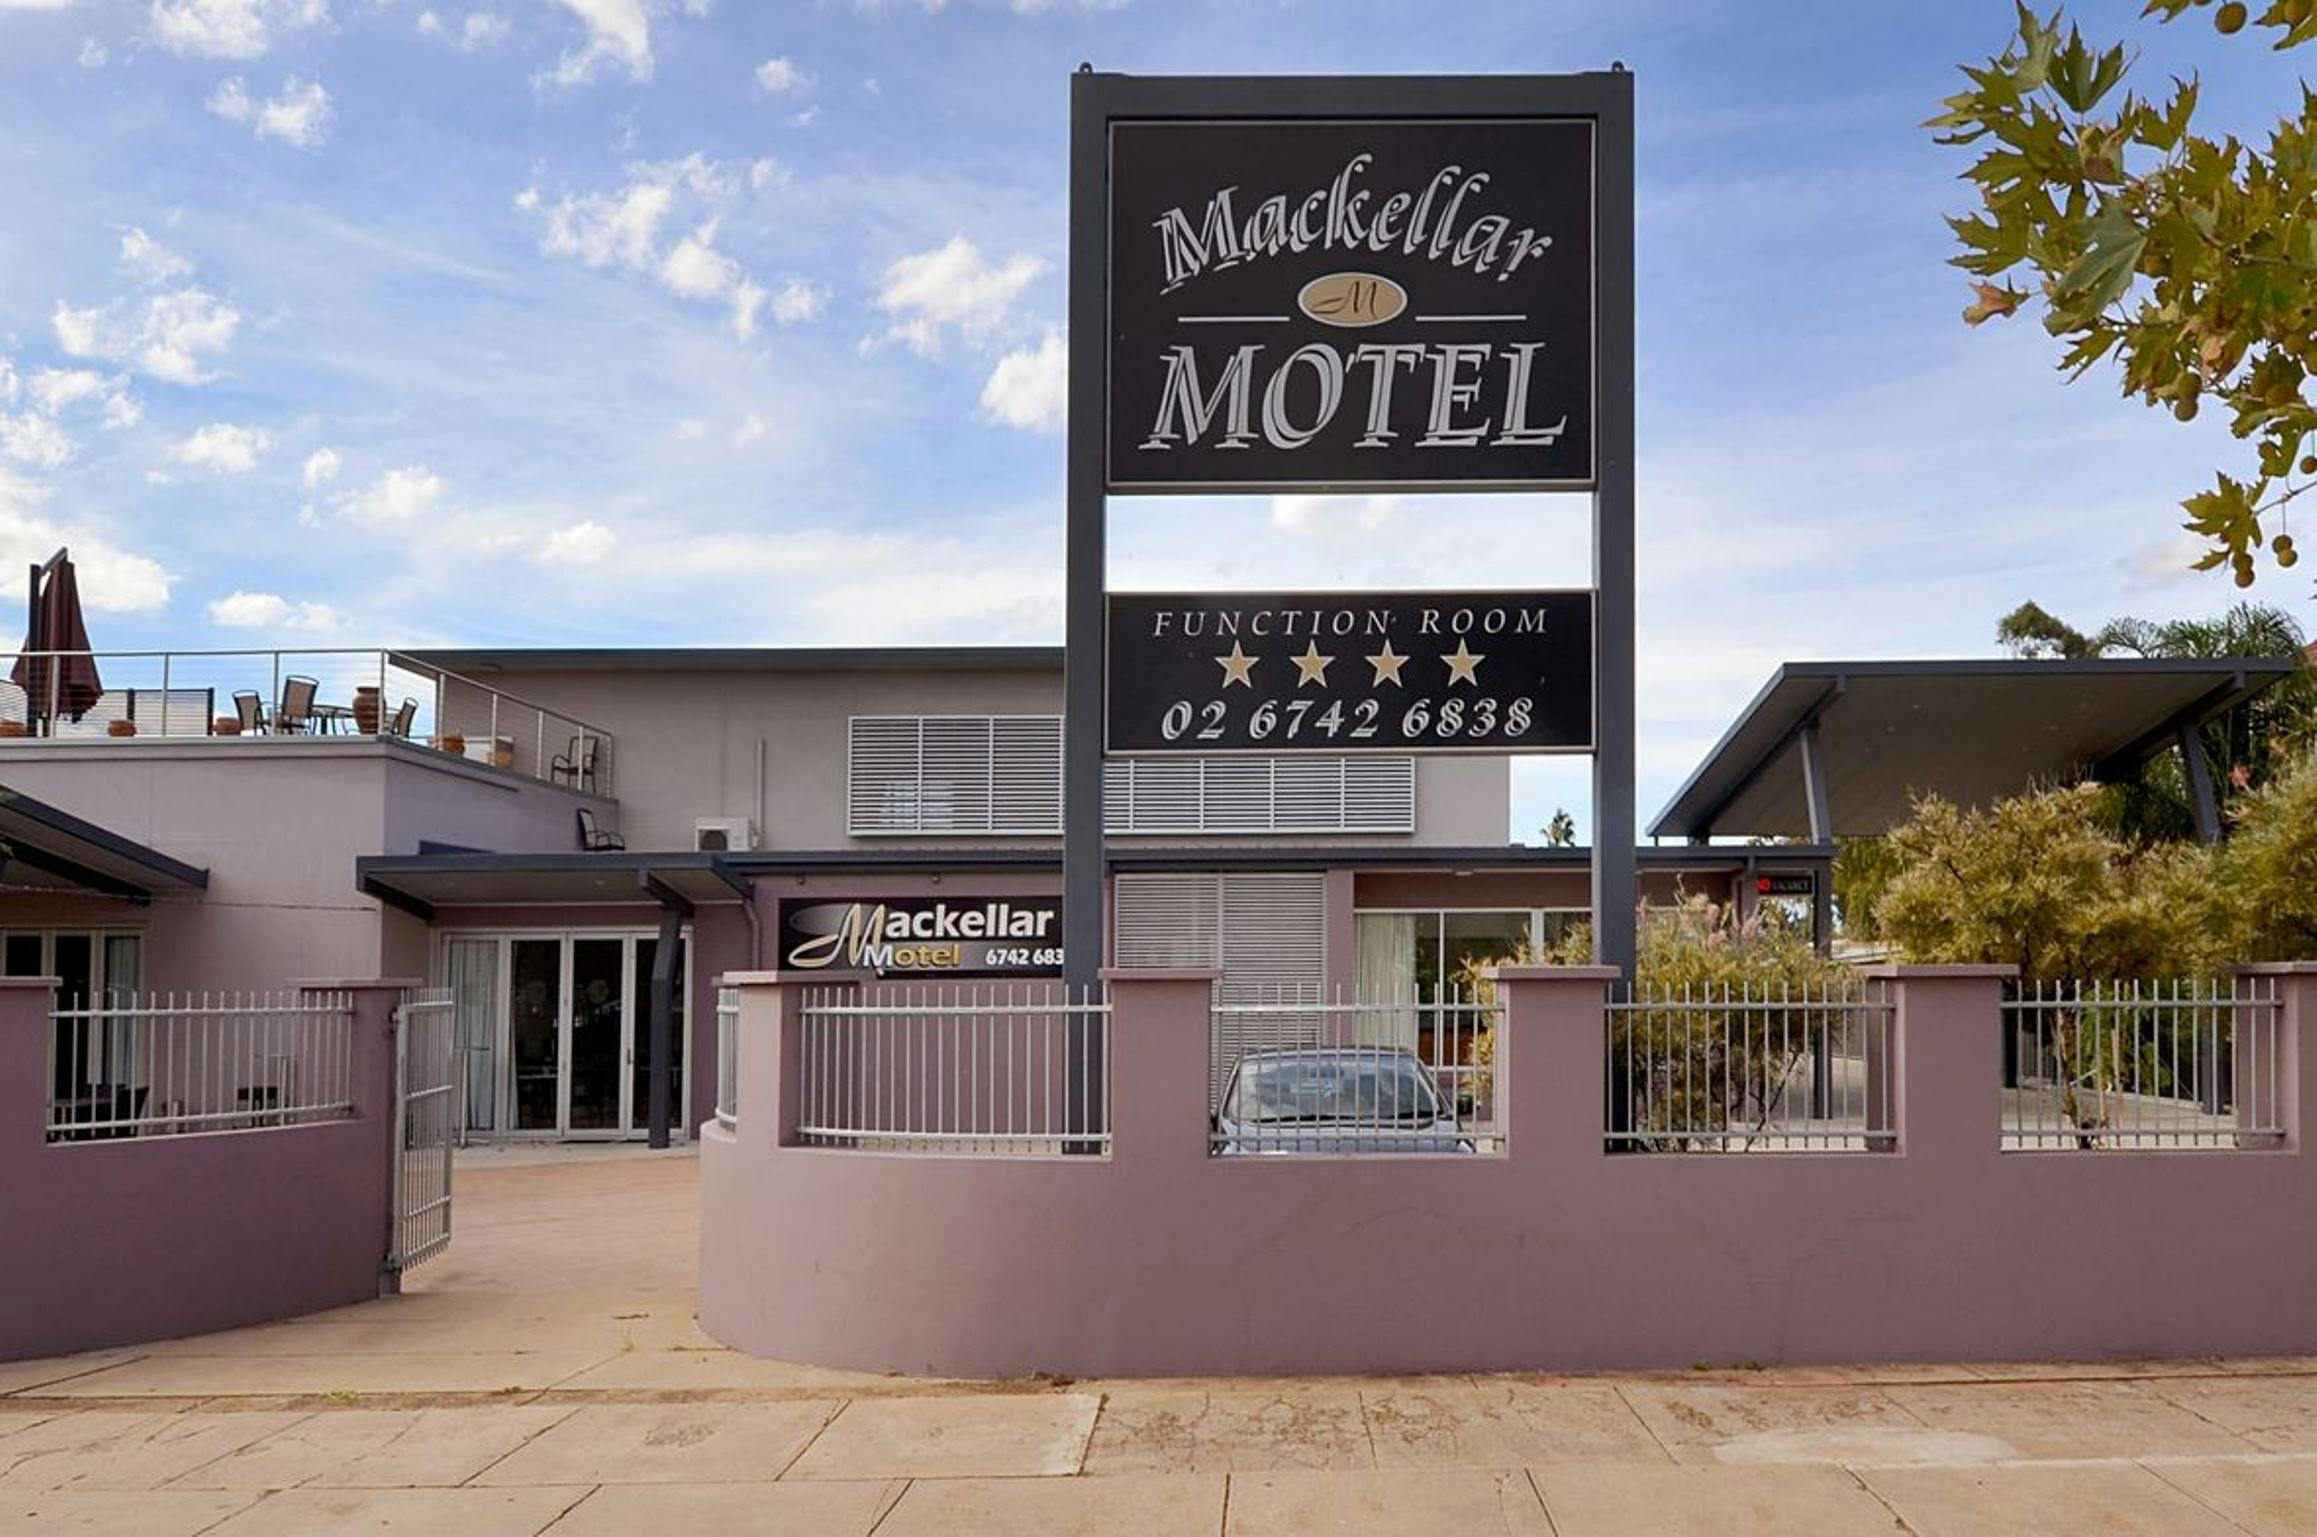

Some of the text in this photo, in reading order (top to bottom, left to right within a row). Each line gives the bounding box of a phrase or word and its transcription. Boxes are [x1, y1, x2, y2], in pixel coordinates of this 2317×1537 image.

[1151, 153, 1554, 294] Mackellar
[1139, 342, 1568, 450] MOTEL
[1152, 608, 1549, 636] FUNCTION ROOM
[1161, 696, 1535, 740] 02 6742 6838
[788, 903, 1055, 967] Mackellar
[863, 943, 961, 967] Motel
[985, 948, 1029, 965] 6742
